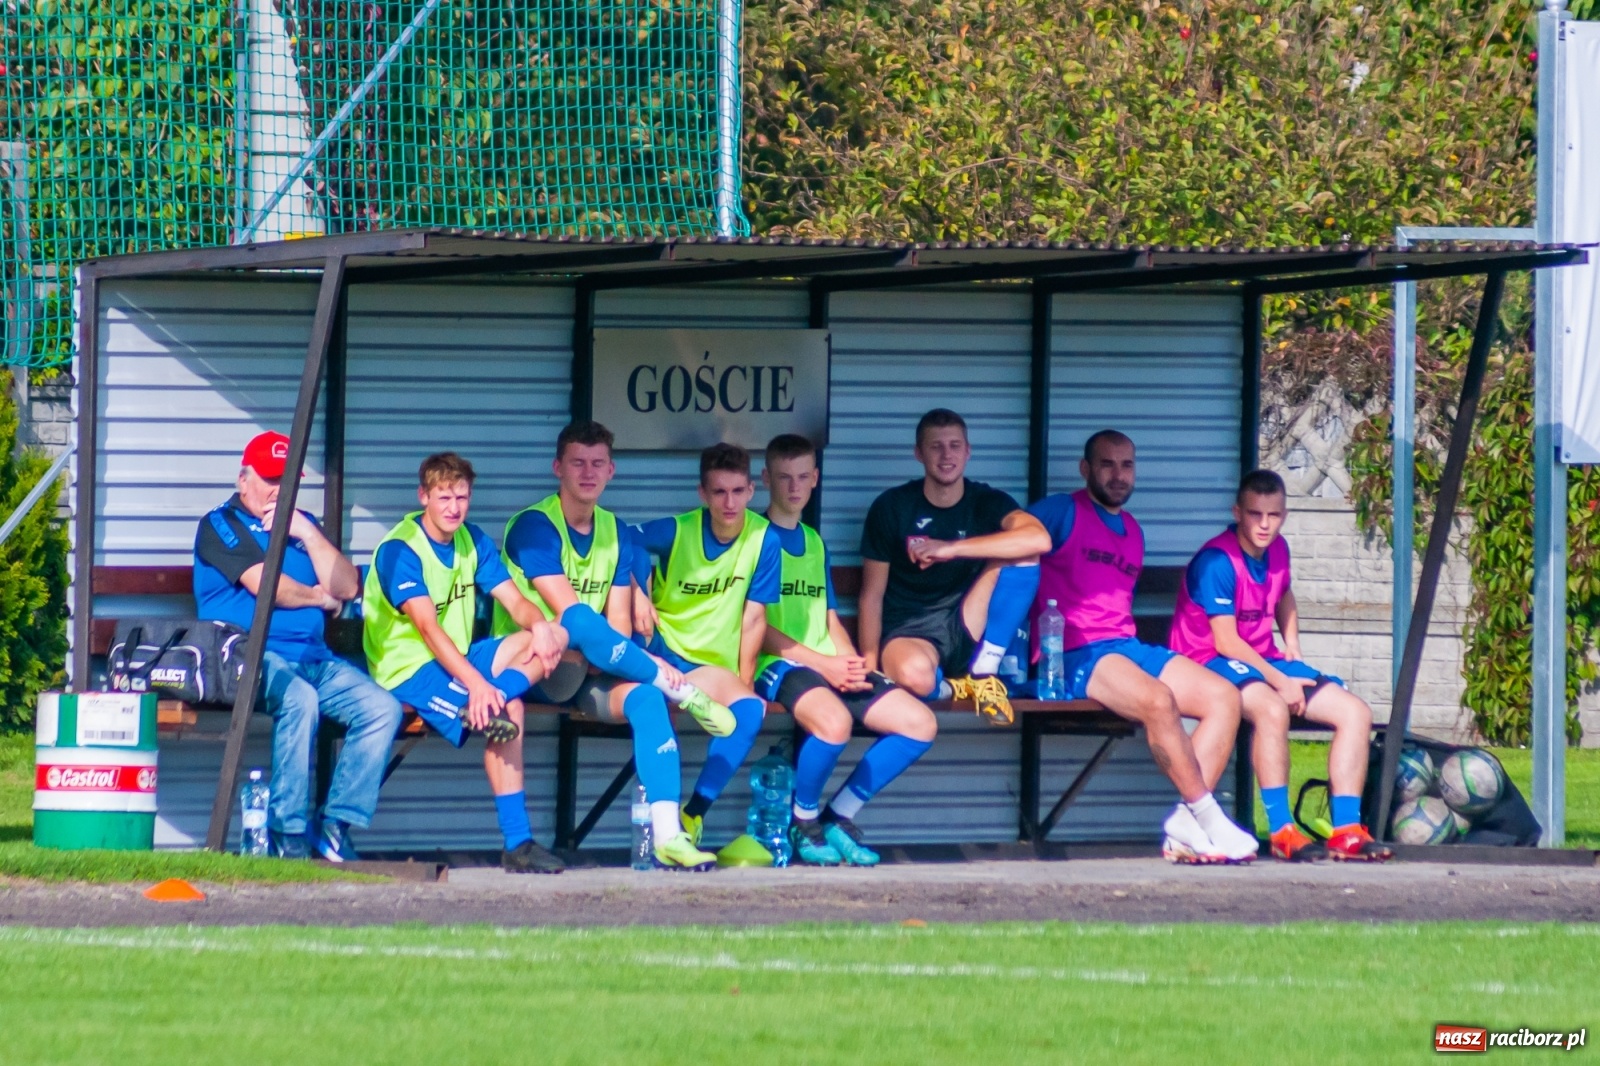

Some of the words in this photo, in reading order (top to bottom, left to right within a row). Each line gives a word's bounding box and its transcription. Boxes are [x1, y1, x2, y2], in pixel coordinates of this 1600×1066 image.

[627, 350, 795, 413] GOŚCIE
[150, 668, 187, 681] SELECT
[60, 768, 115, 787] Castrol
